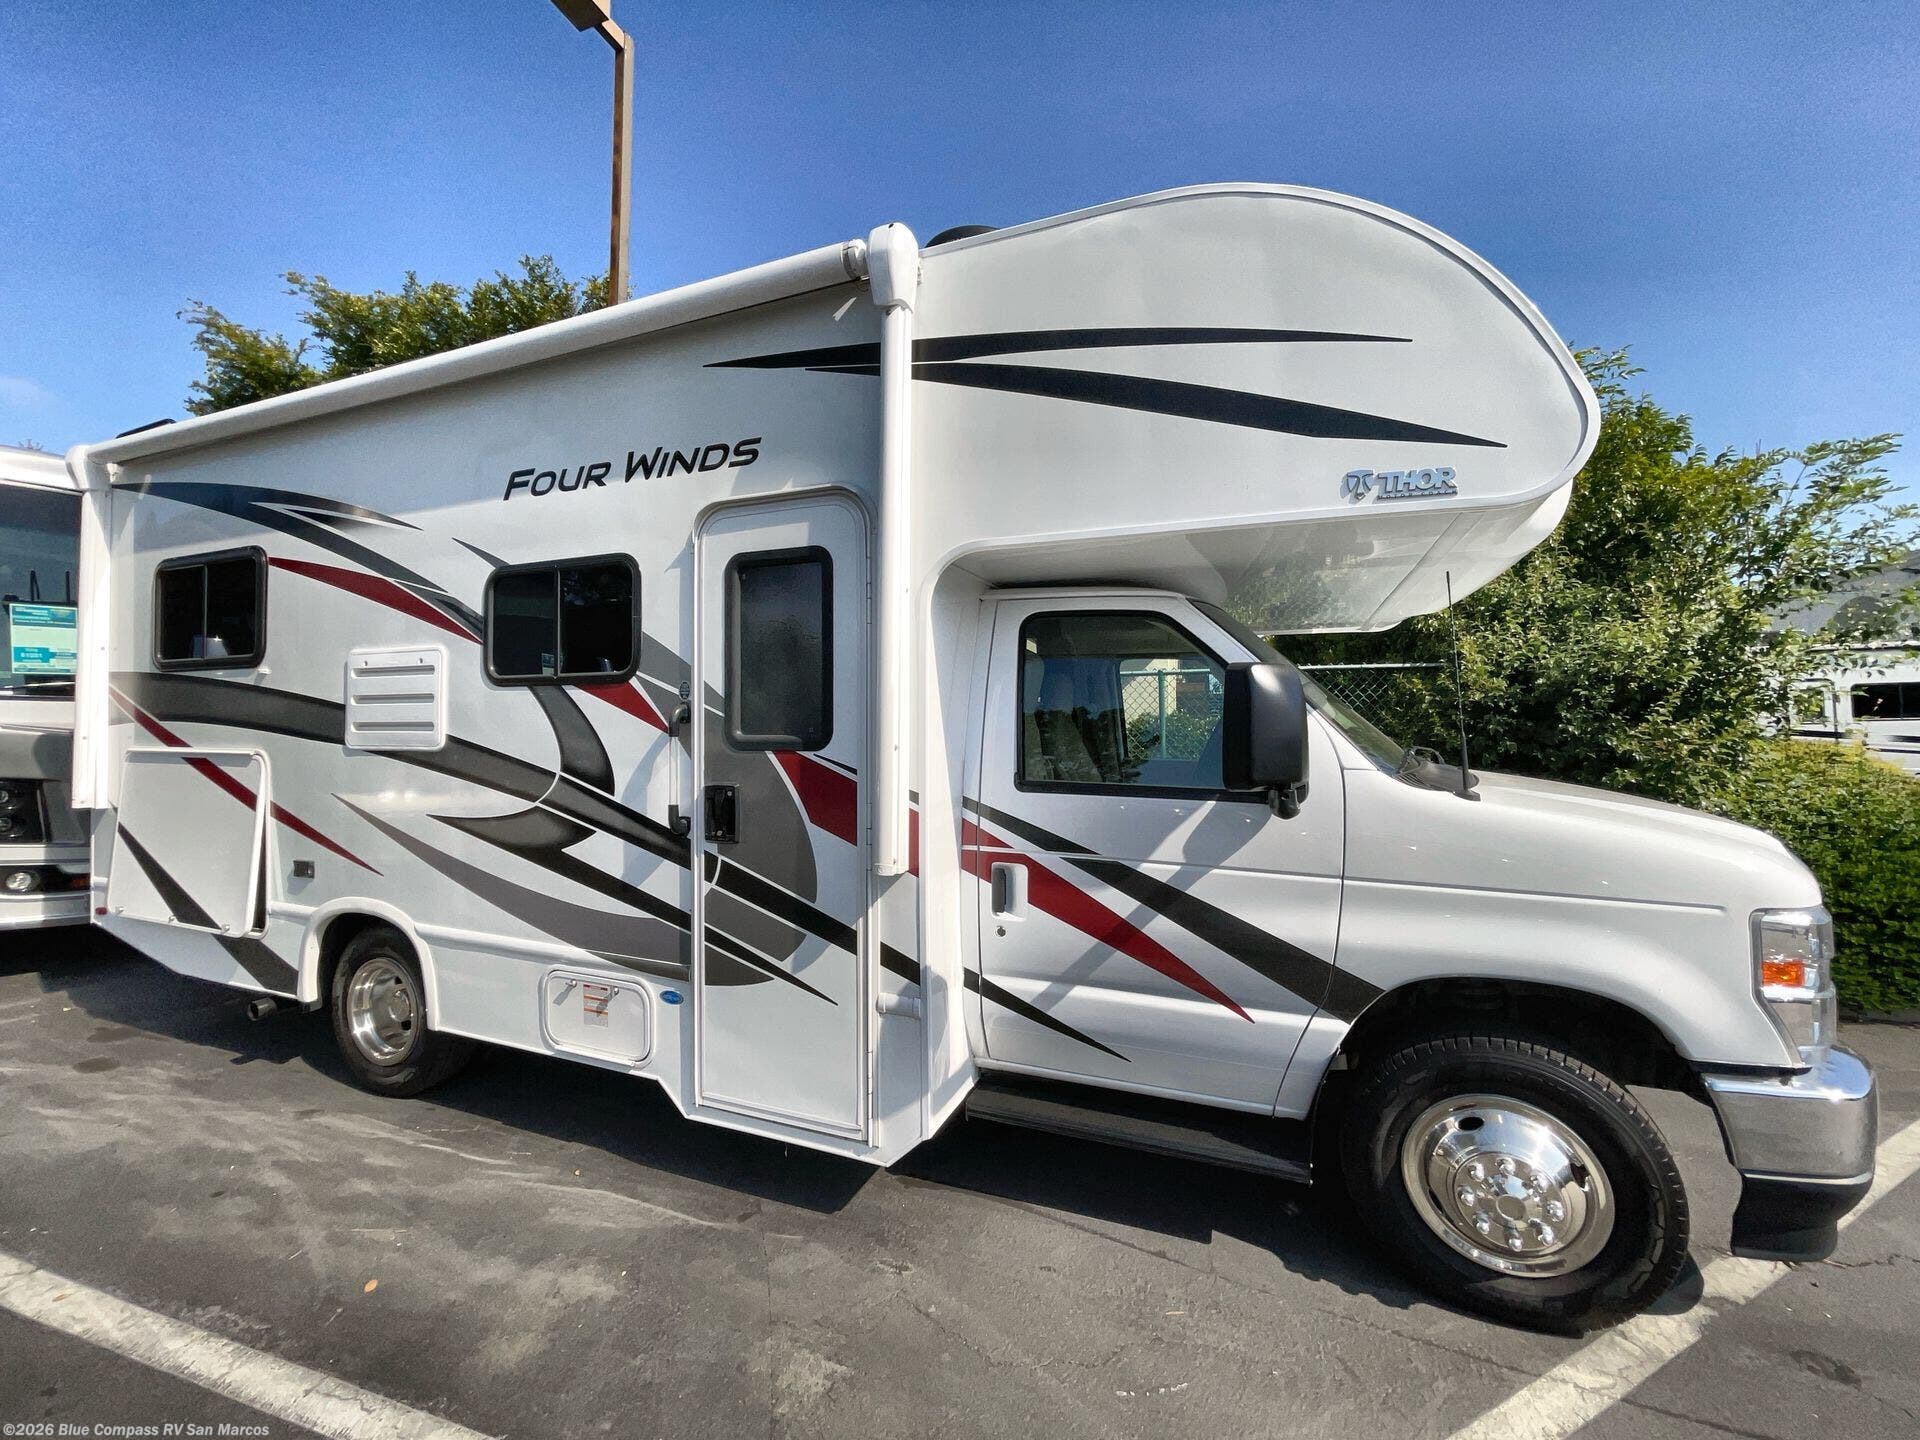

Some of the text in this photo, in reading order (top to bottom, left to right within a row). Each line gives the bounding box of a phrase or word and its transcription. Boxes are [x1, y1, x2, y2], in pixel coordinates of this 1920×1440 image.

[503, 437, 762, 501] FOUR WINDS
[1378, 467, 1457, 493] THOR
